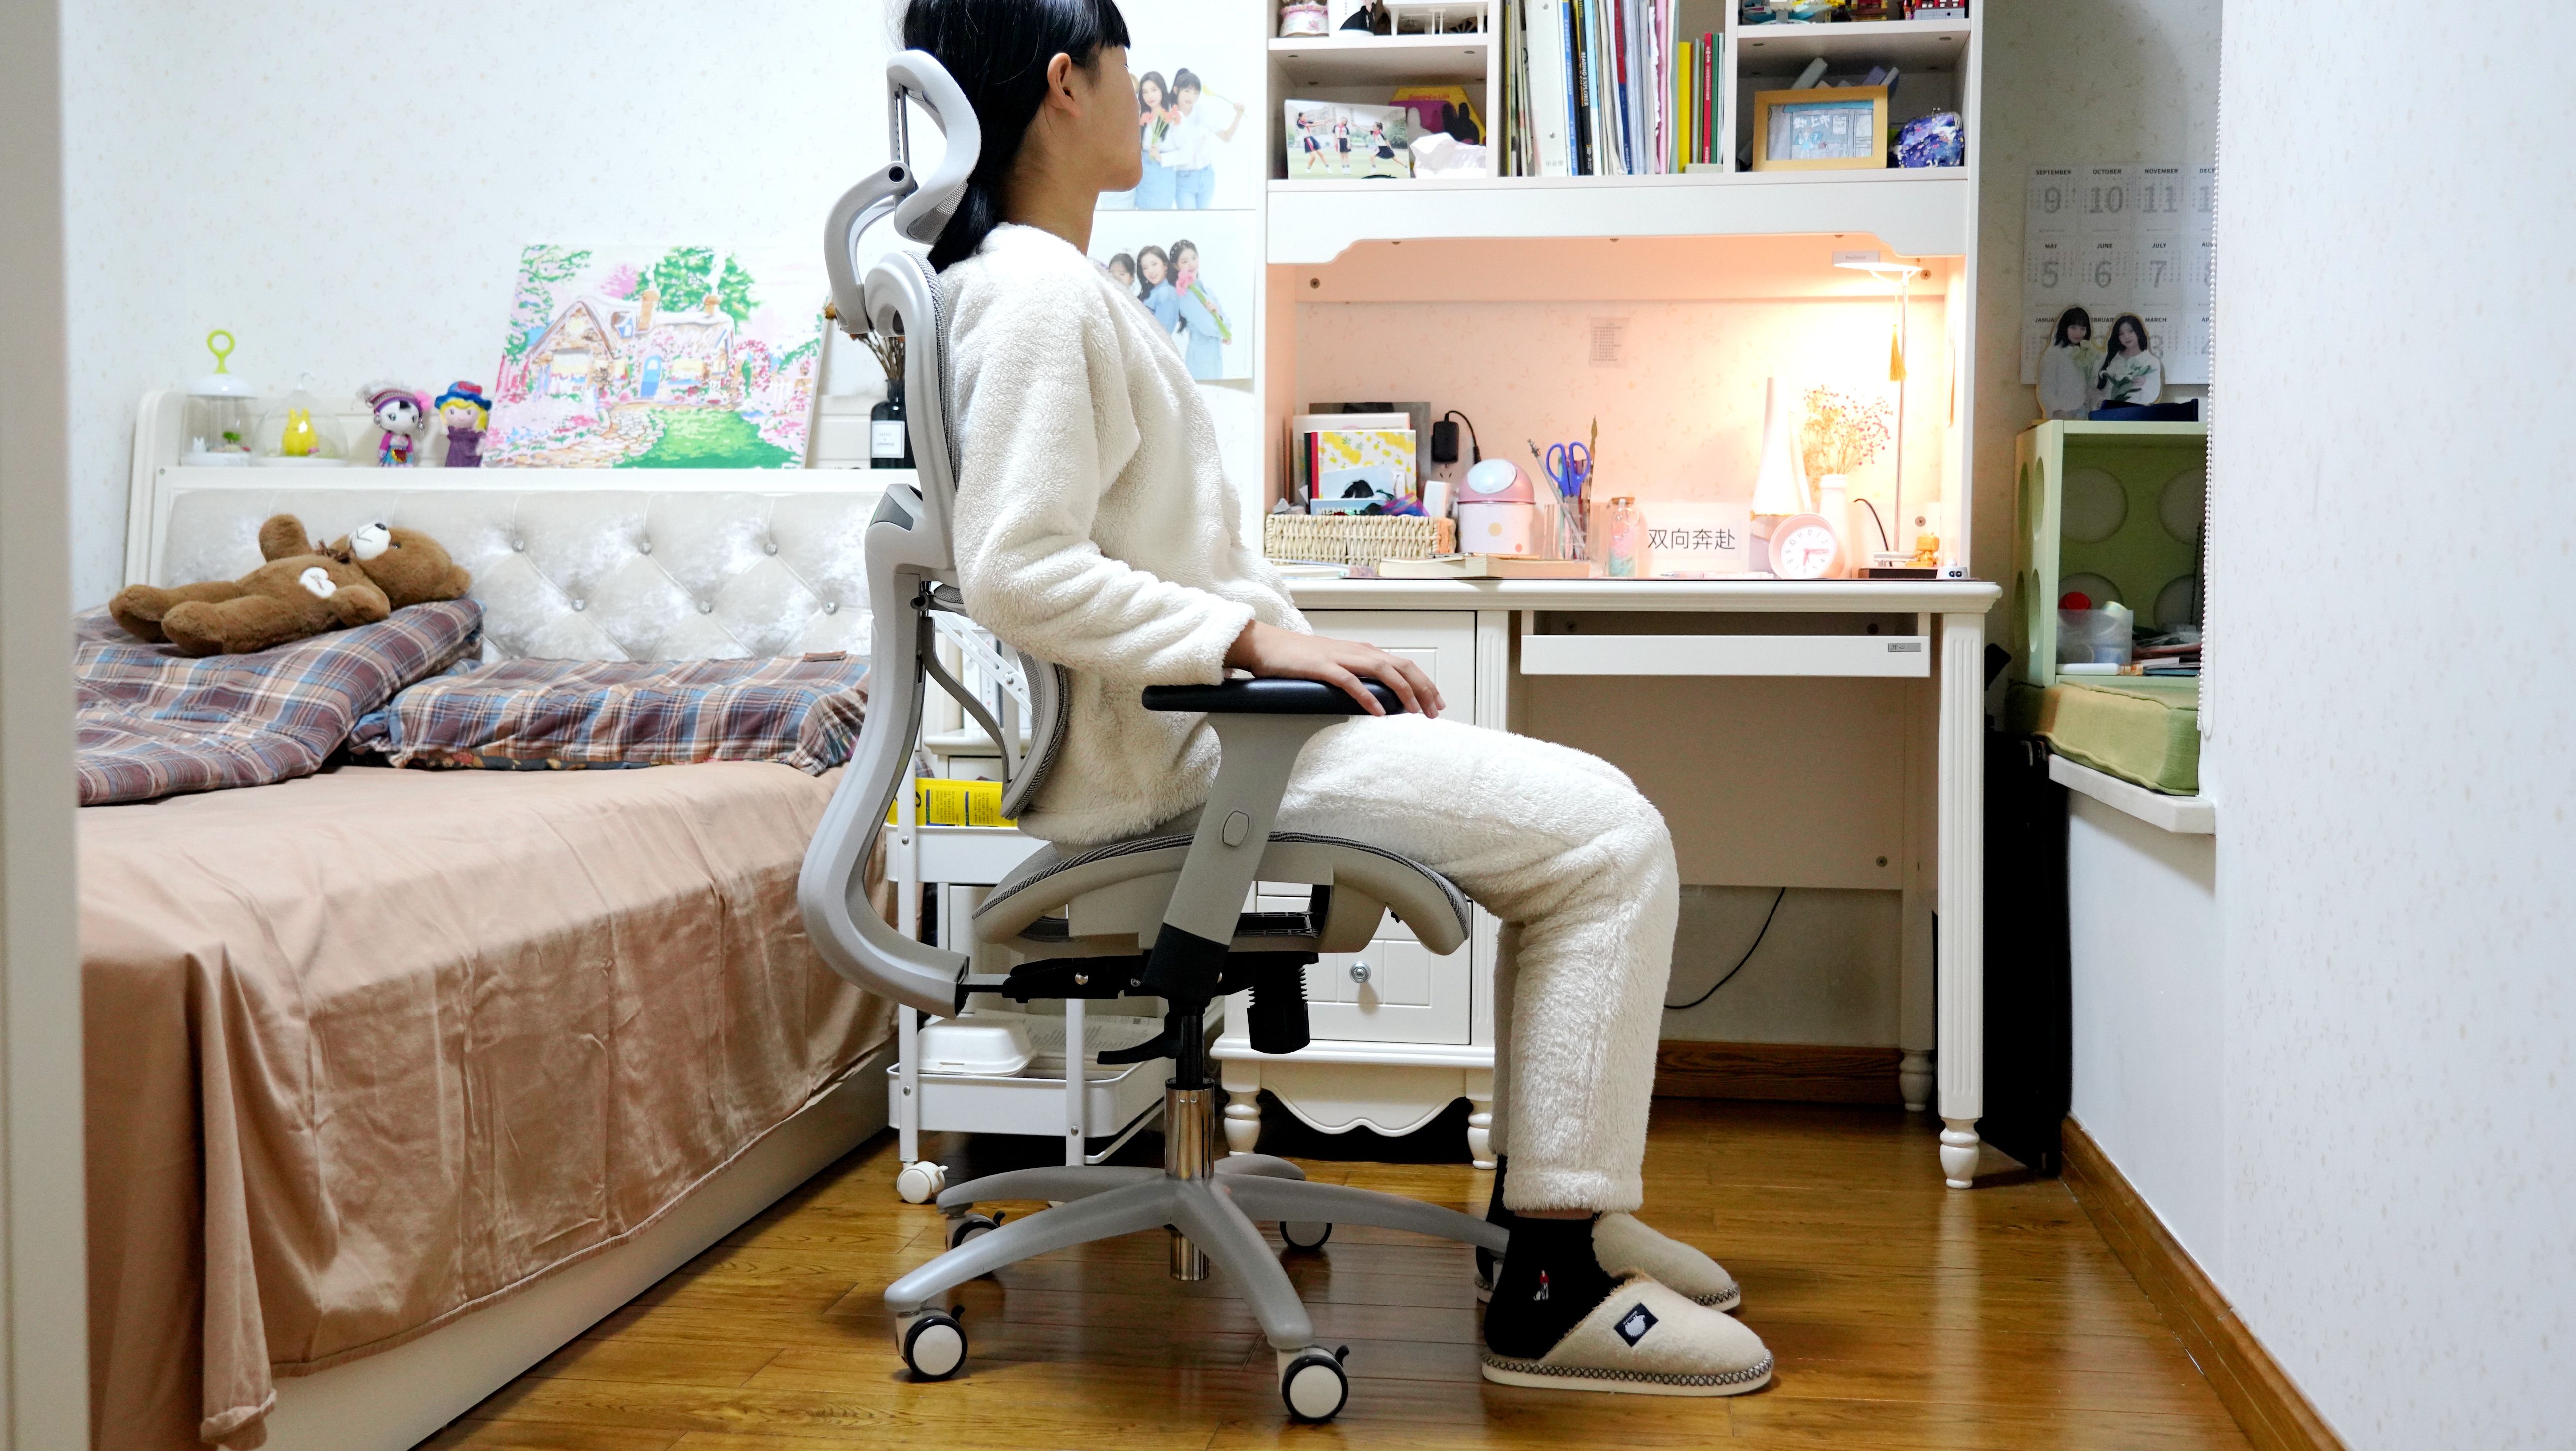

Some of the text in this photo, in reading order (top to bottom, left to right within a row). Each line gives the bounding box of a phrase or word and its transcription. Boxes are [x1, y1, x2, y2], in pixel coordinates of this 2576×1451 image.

[2044, 186, 2061, 214] 9
[2089, 186, 2124, 214] 10
[2143, 186, 2178, 213] 11
[2198, 185, 2213, 212] 1
[2042, 261, 2059, 288] 5
[2095, 260, 2112, 288] 6
[2150, 260, 2167, 288] 7
[1648, 528, 1735, 550] 双向奔赴
